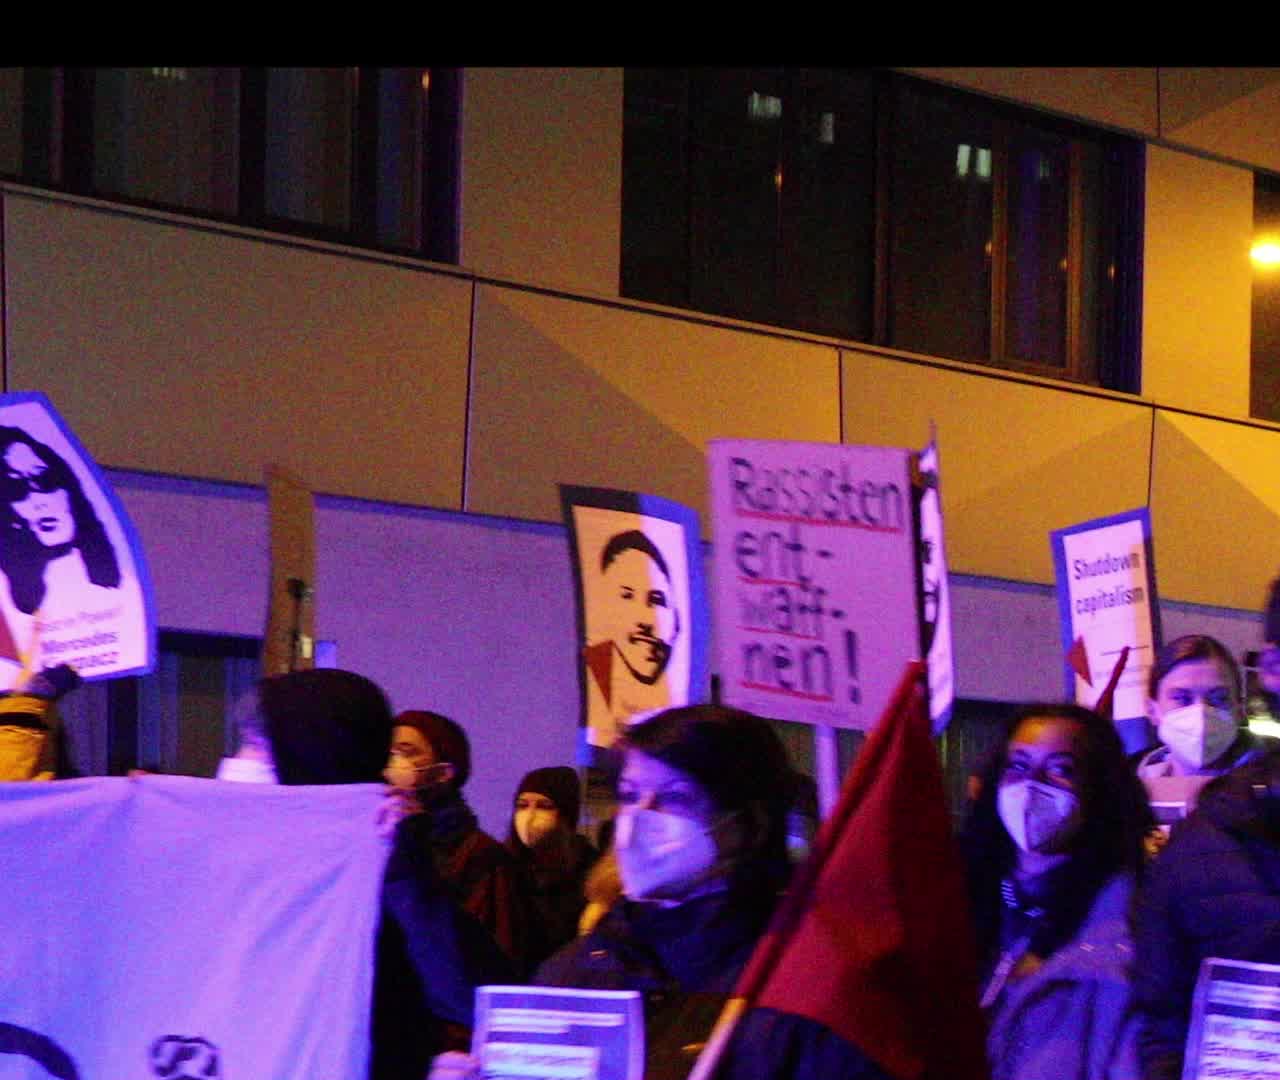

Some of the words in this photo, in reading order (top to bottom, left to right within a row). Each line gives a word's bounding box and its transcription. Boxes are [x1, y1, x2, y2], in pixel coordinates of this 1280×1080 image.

[732, 457, 903, 525] Rassisten
[1073, 553, 1141, 580] Shutdown
[1076, 585, 1144, 616] capitalism
